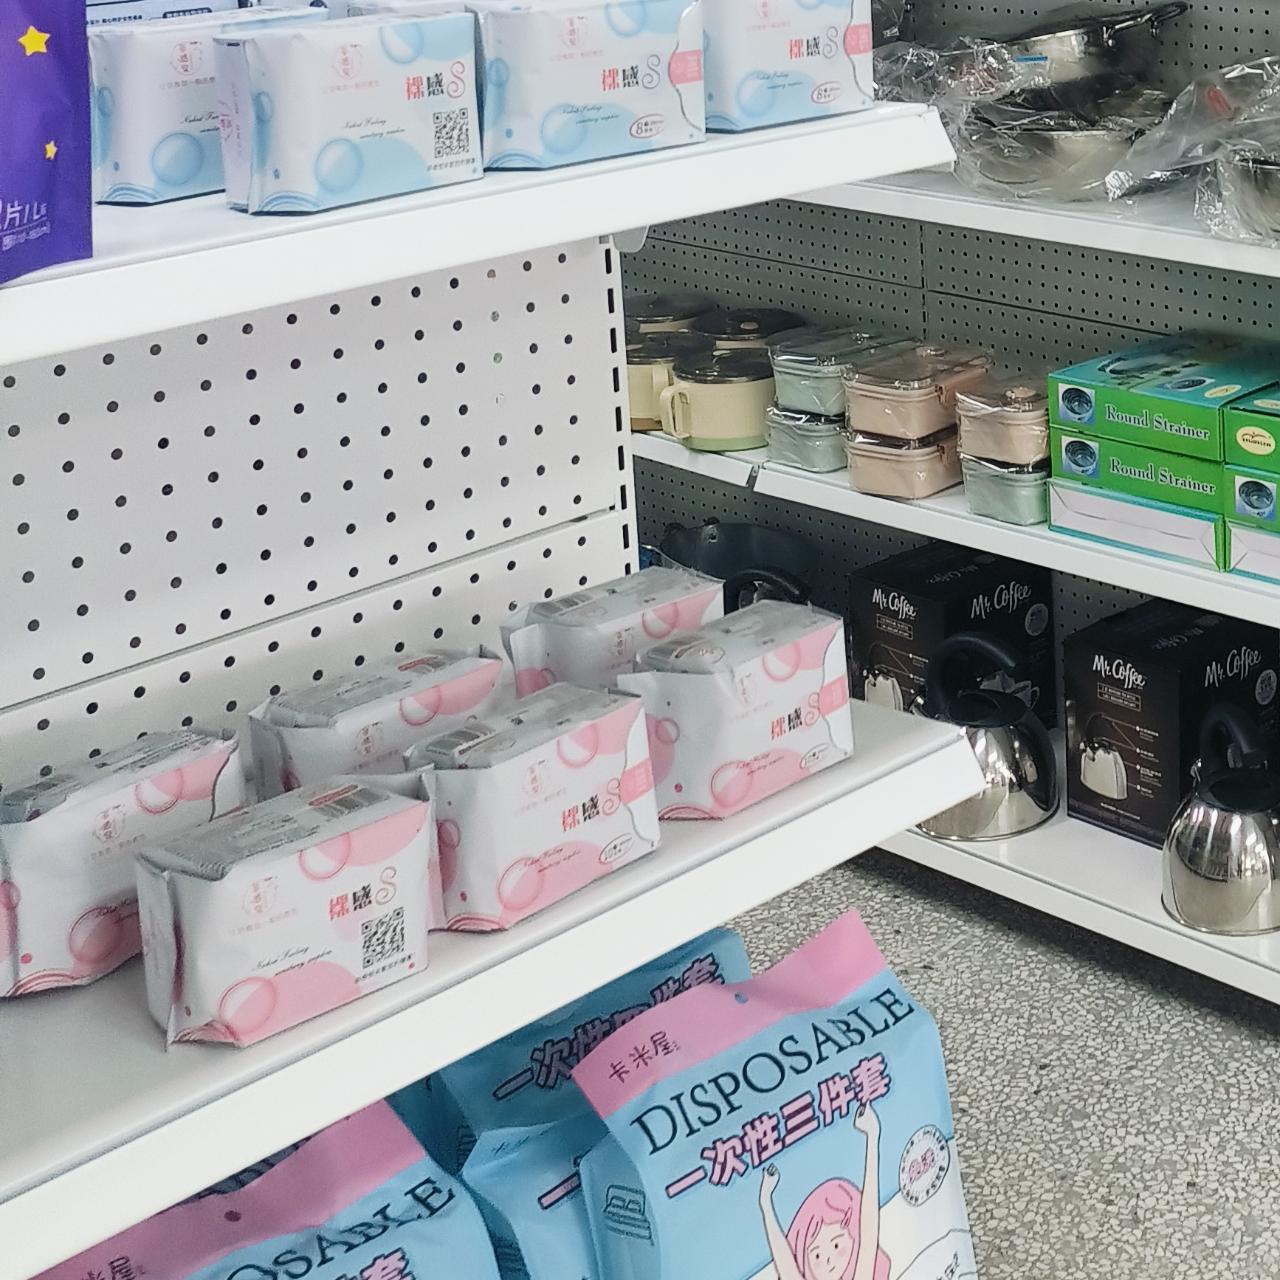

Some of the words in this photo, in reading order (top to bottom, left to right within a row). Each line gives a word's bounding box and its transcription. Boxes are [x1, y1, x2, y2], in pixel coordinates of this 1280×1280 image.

[1106, 404, 1149, 427] Round
[1153, 414, 1209, 441] Strainer
[1110, 457, 1154, 481] Round
[1158, 467, 1216, 495] Strainer
[888, 592, 917, 619] Coffee
[970, 594, 992, 619] Mr.
[994, 581, 1032, 613] Coffee
[1093, 654, 1111, 679] Mr.
[1112, 659, 1146, 689] Coffee
[1204, 661, 1226, 687] Mr.
[1227, 646, 1262, 681] Coffee
[630, 988, 915, 1156] DISPOSABLE
[665, 1052, 892, 1200] 一次性三件套
